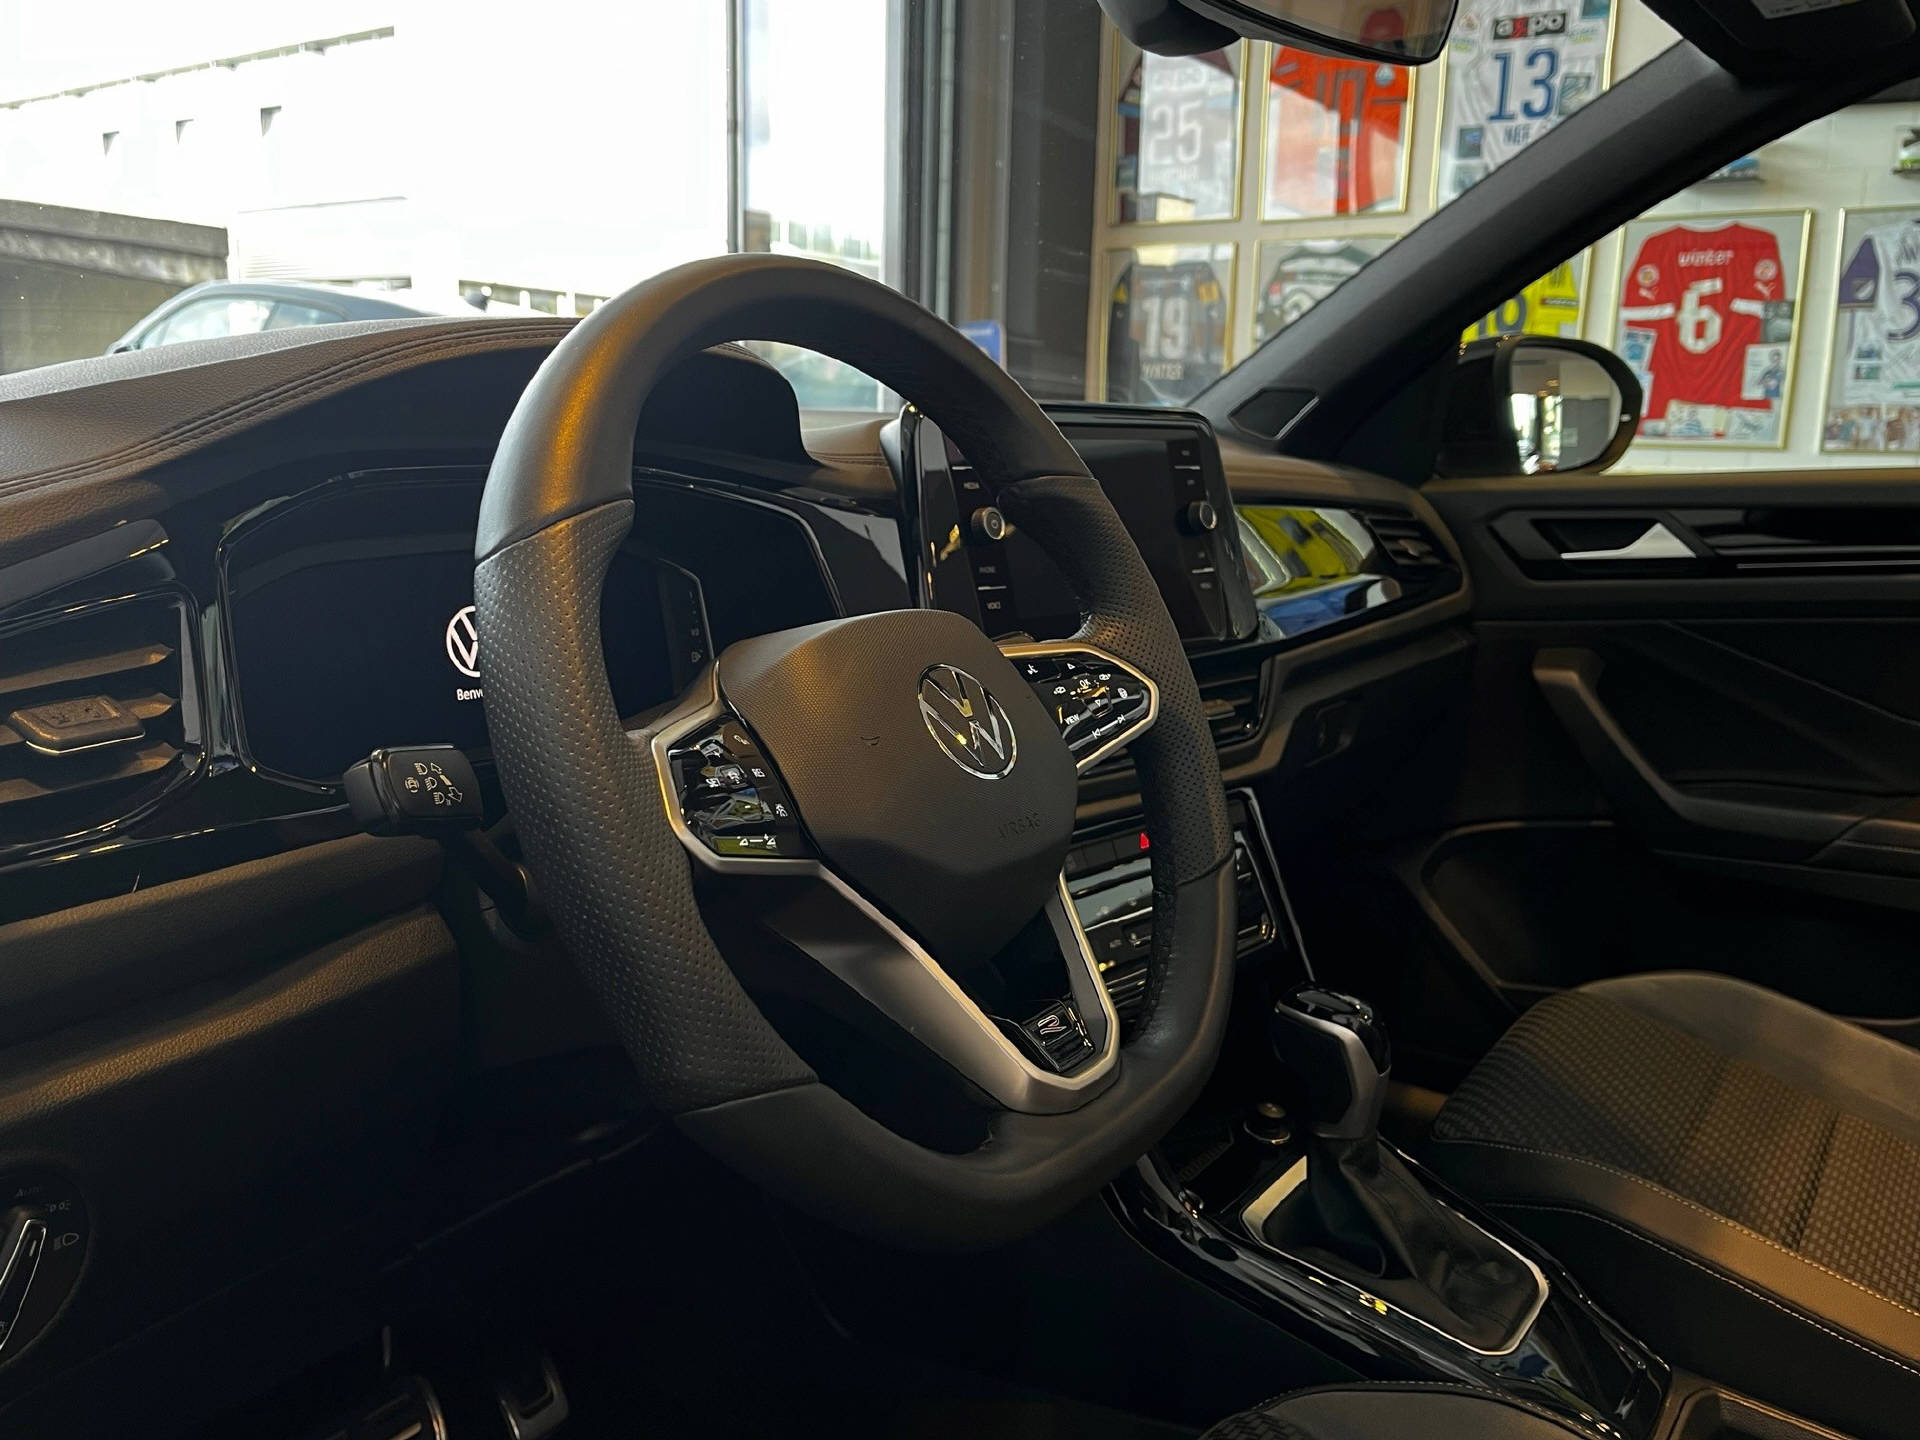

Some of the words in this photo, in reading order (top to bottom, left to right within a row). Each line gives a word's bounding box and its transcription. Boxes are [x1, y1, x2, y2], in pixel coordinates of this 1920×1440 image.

[1486, 48, 1558, 121] 13
[1148, 102, 1202, 164] 25
[1141, 296, 1186, 359] 19
[1677, 277, 1723, 354] 6
